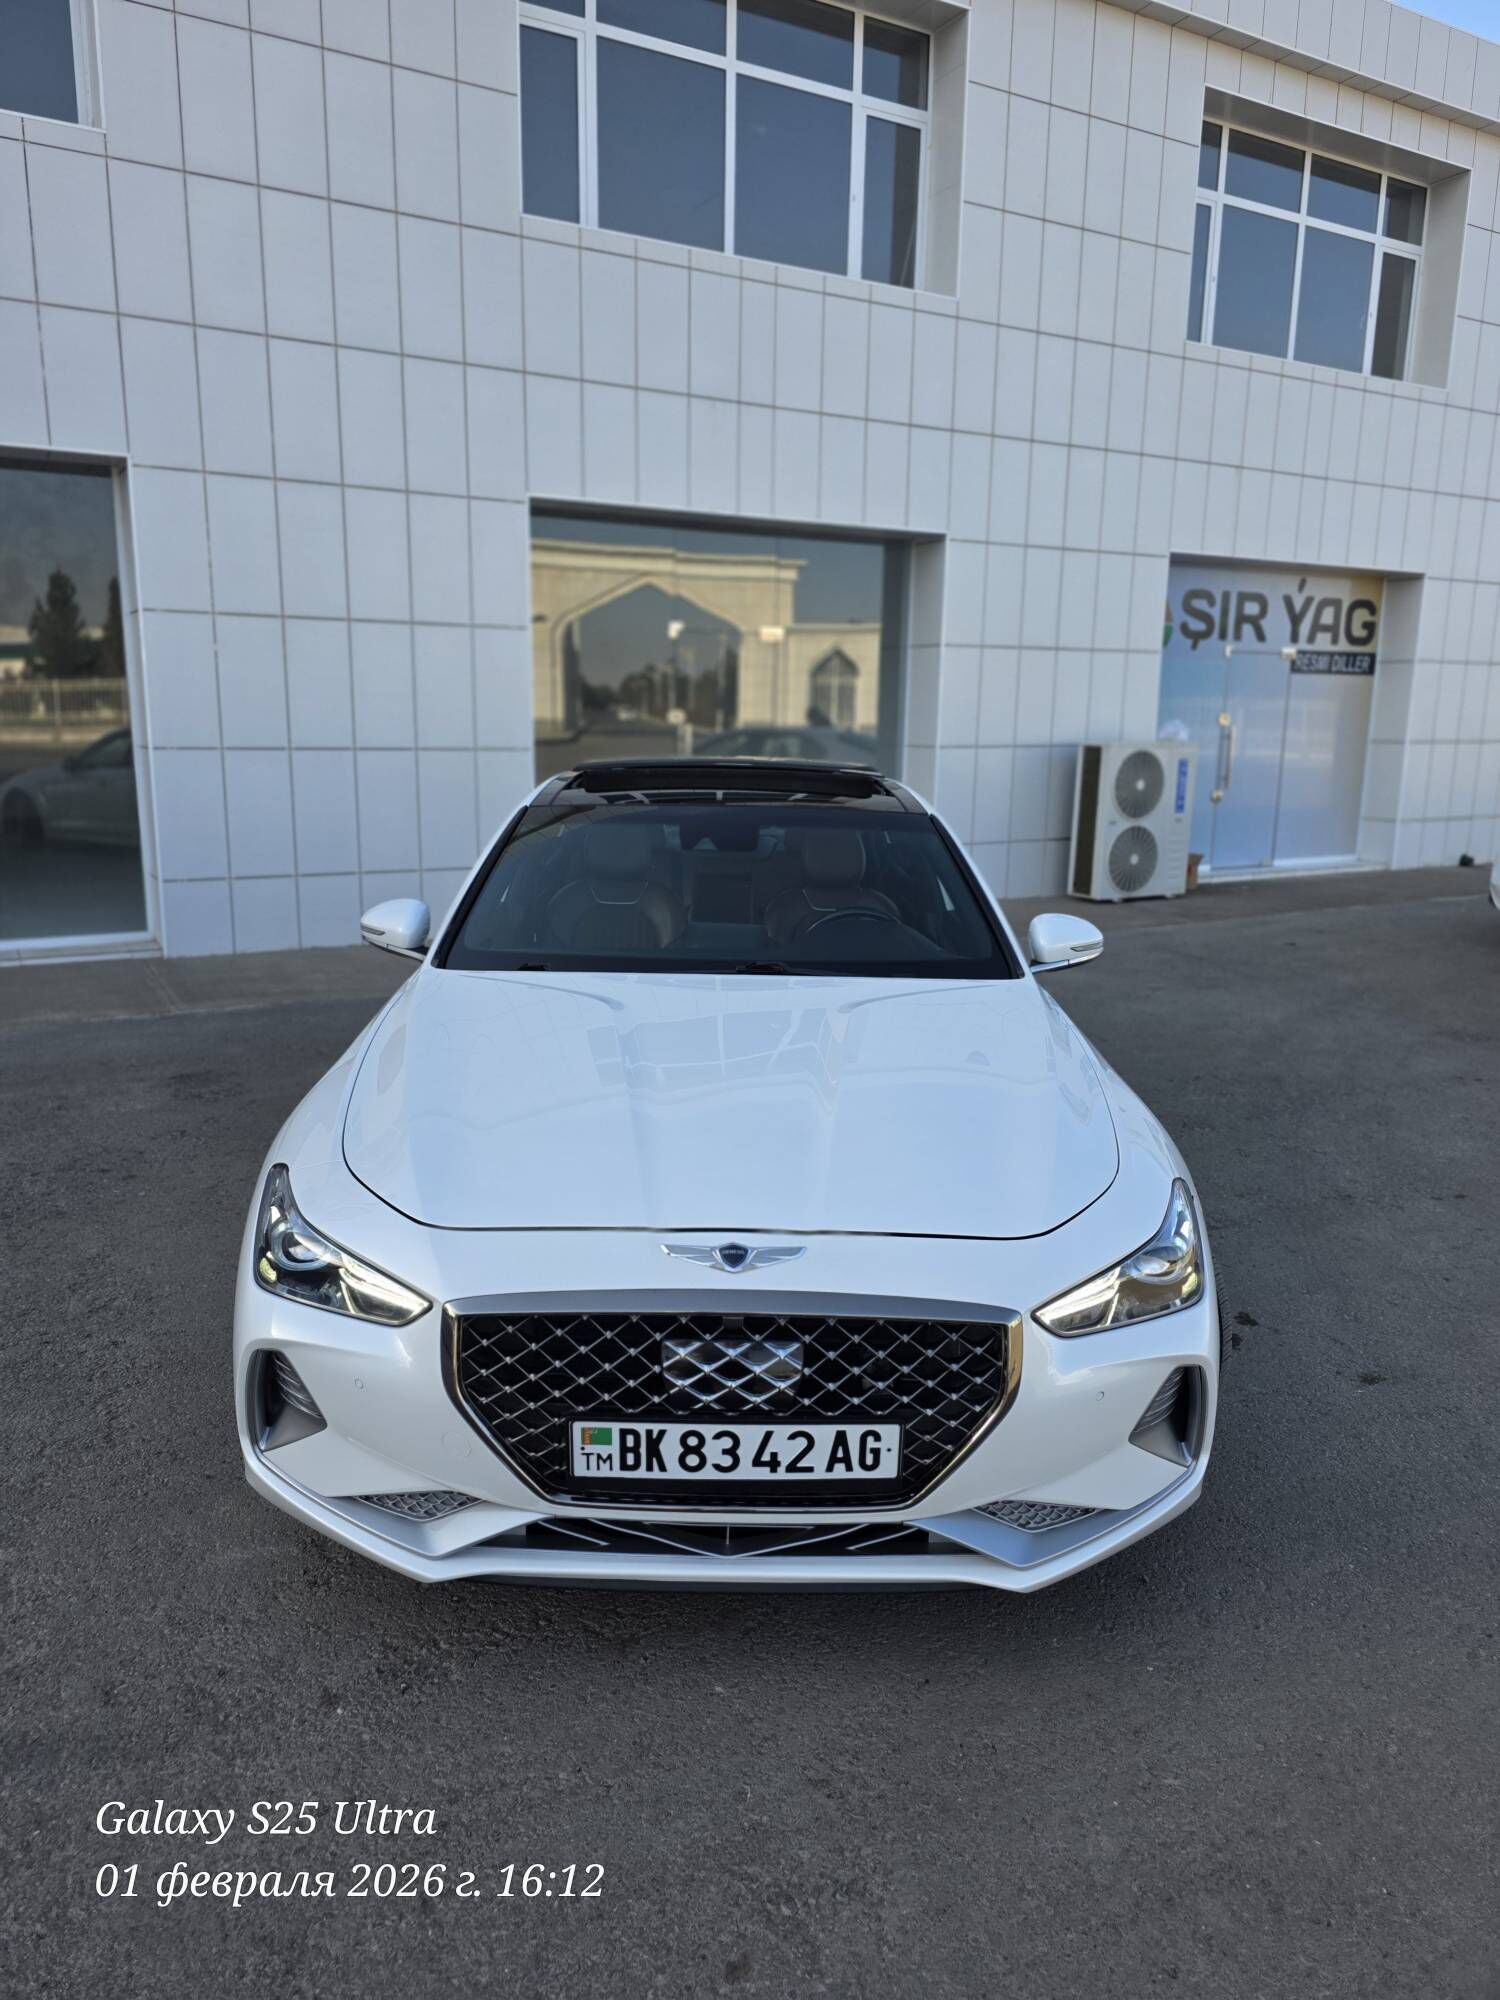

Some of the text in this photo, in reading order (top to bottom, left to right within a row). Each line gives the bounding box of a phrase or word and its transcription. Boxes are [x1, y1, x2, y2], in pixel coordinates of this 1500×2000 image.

[1179, 576, 1377, 651] ŞIR ÝAG
[581, 1453, 613, 1471] TM
